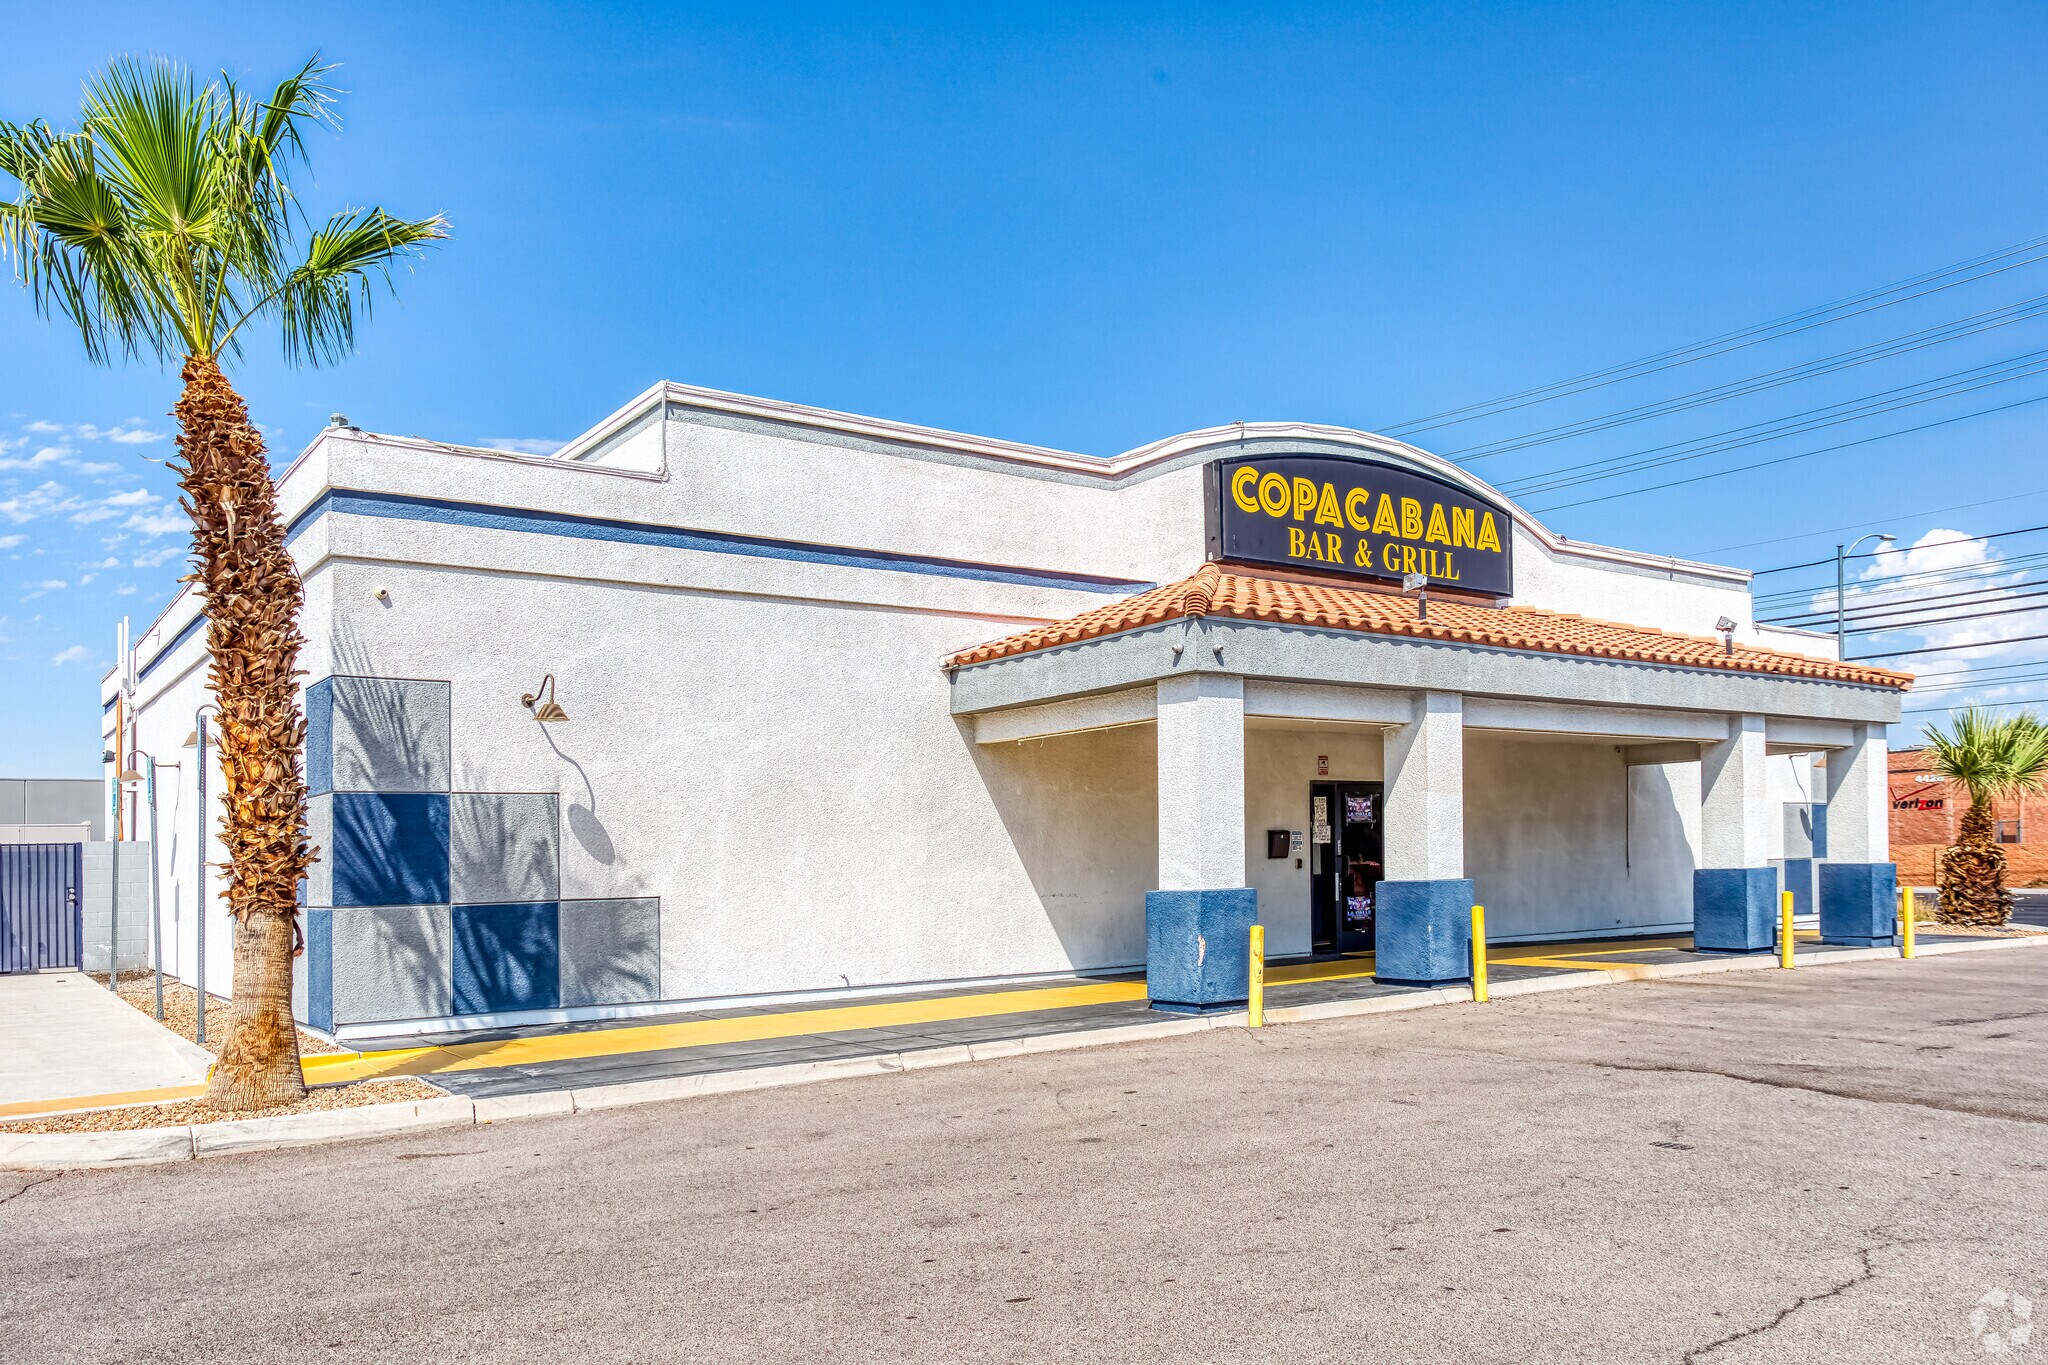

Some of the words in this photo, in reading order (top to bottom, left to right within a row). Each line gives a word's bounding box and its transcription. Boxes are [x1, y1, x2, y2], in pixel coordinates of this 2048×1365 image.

[1231, 466, 1501, 552] COPACABANA
[1287, 527, 1344, 564] BAR
[1354, 539, 1373, 568] &
[1383, 542, 1460, 581] GRILL
[1892, 797, 1943, 811] verizon
